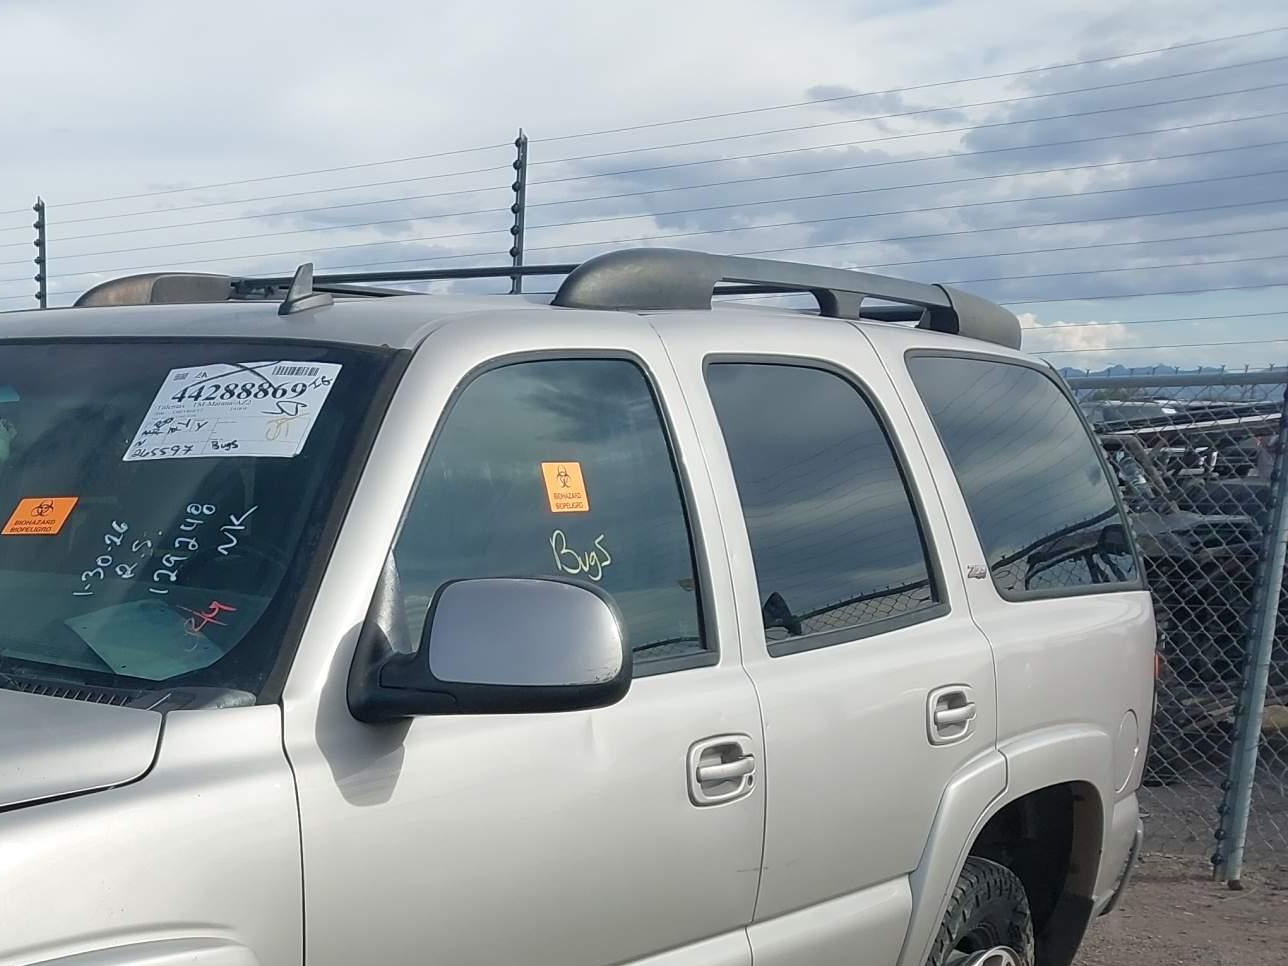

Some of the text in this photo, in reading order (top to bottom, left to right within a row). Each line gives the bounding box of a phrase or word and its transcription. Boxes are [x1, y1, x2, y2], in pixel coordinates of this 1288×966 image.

[171, 381, 308, 403] 44288869
[211, 439, 239, 451] Bugs
[549, 529, 612, 581] Bugs
